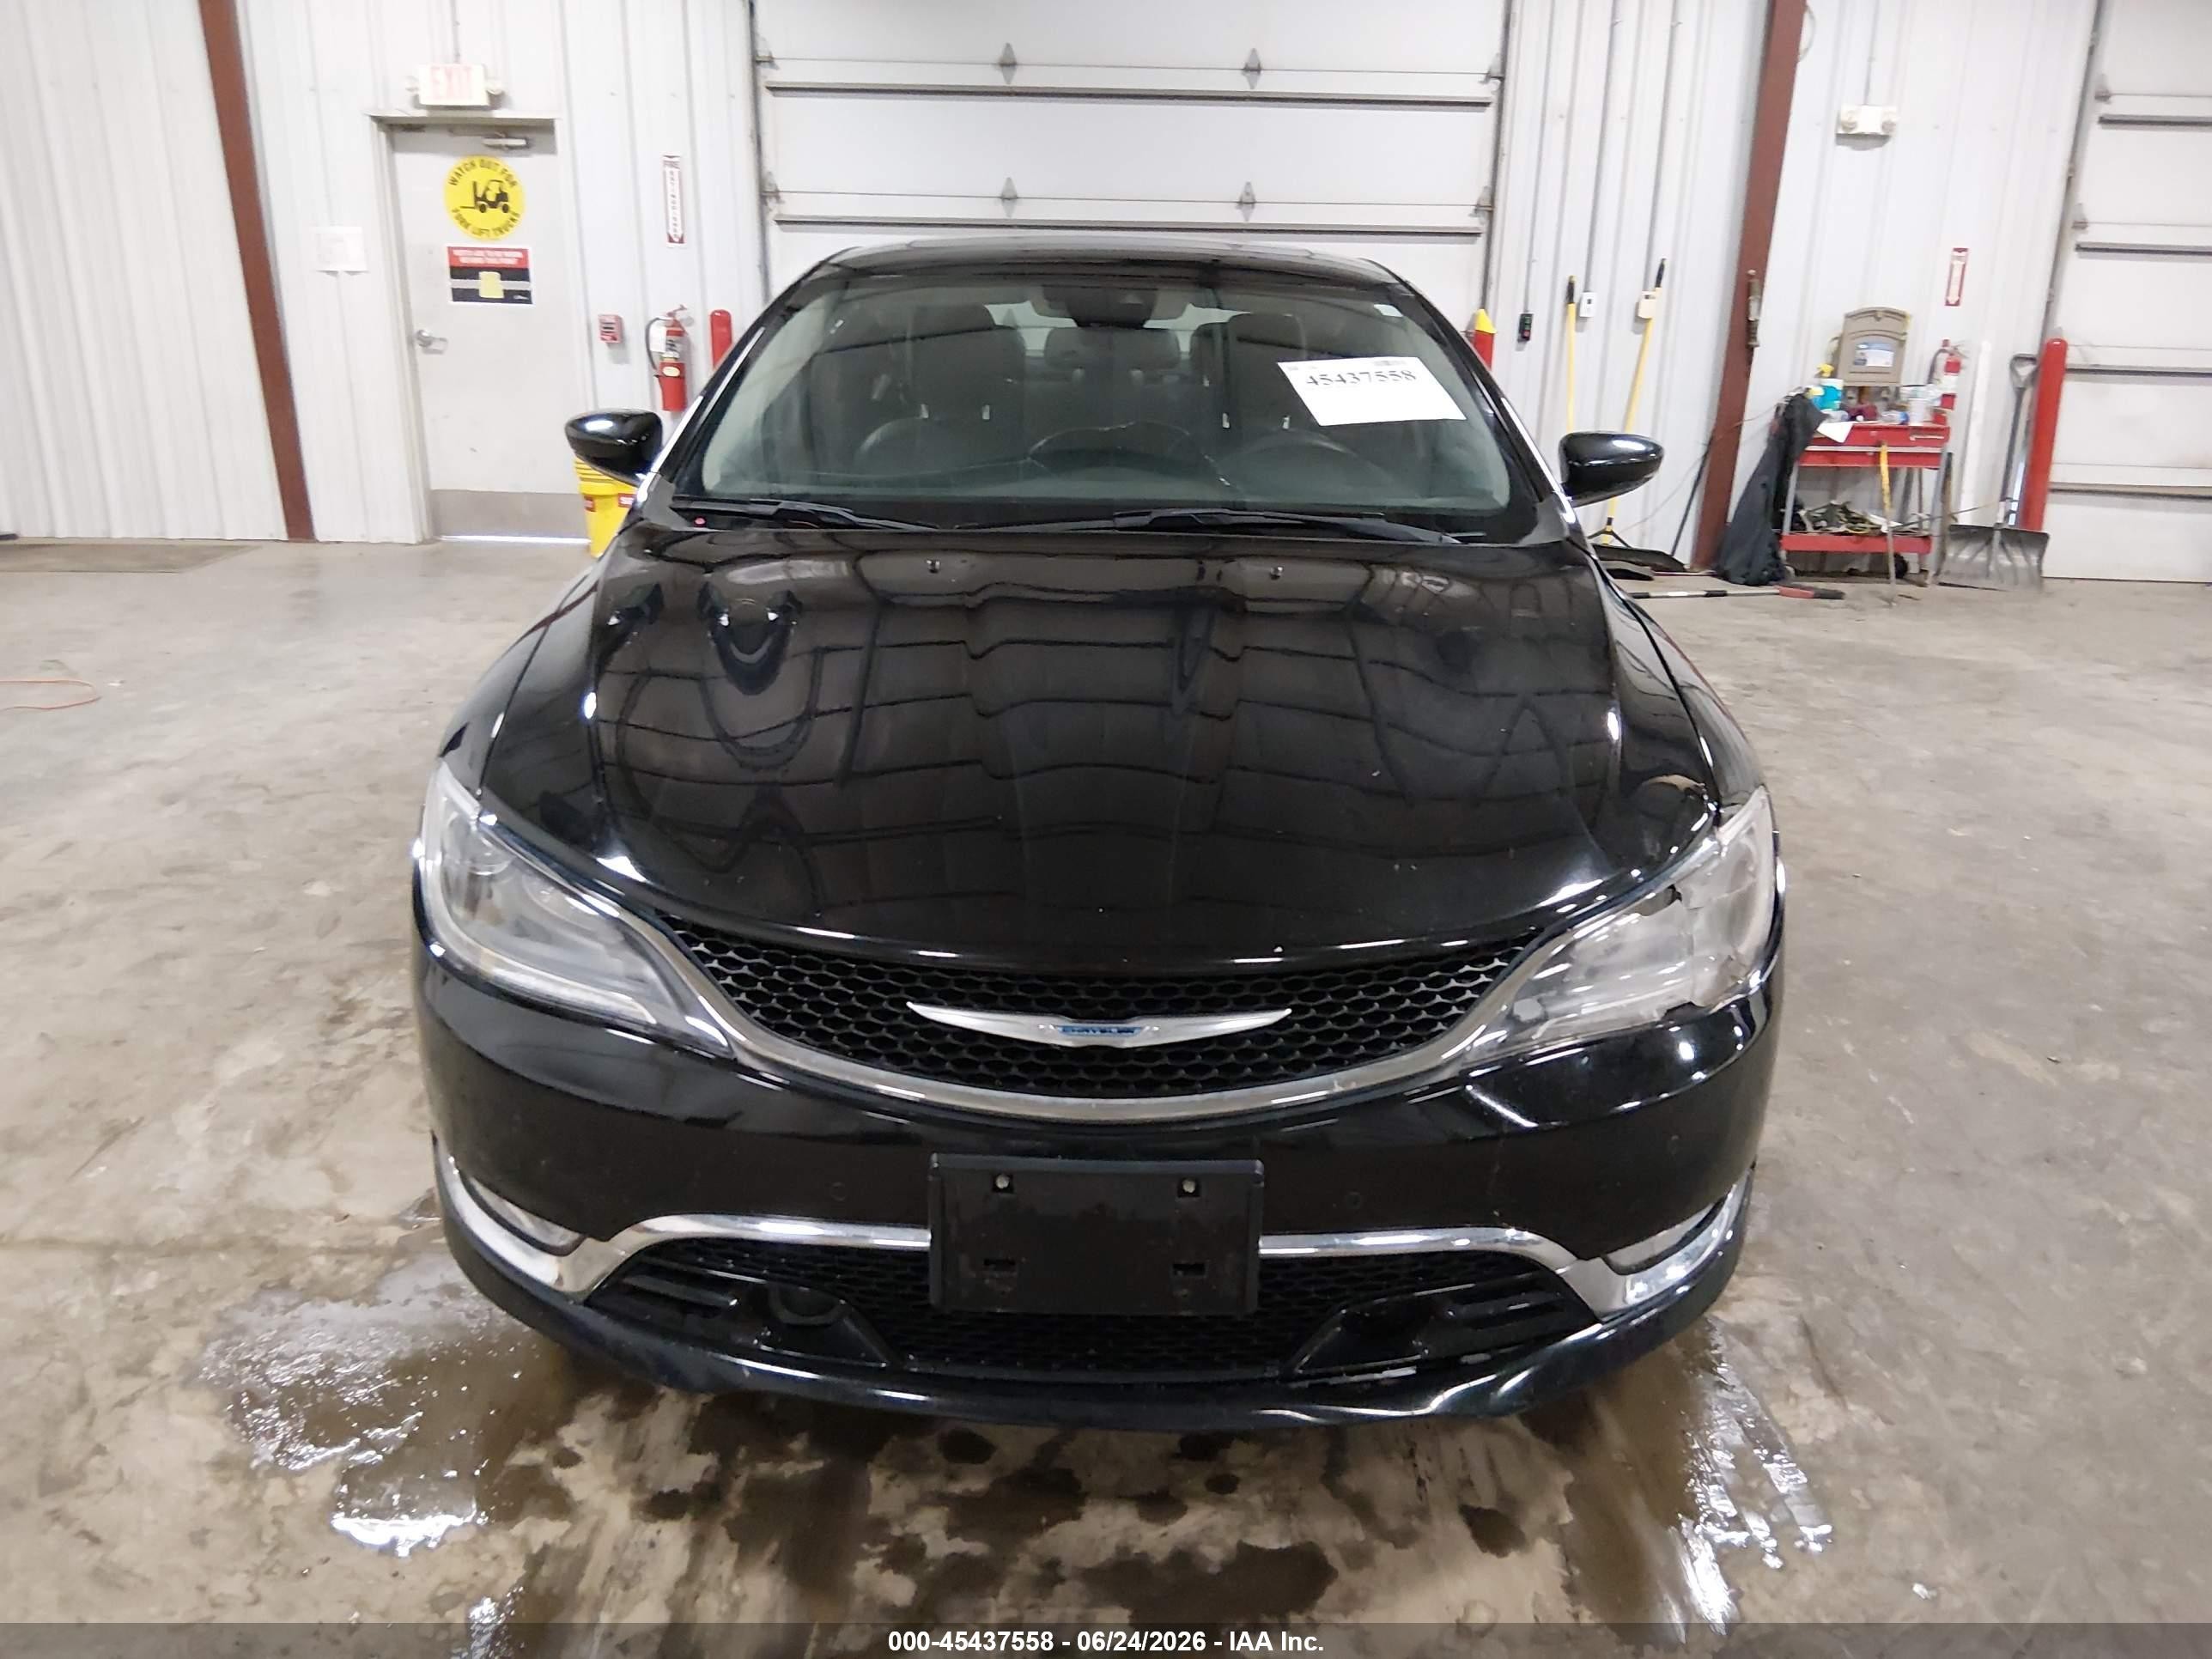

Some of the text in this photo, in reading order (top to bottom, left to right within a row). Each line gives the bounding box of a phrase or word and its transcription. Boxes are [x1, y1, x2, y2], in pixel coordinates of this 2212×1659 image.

[430, 66, 472, 100] EXIT
[447, 160, 477, 186] WATCH
[1306, 369, 1417, 386] 45437558
